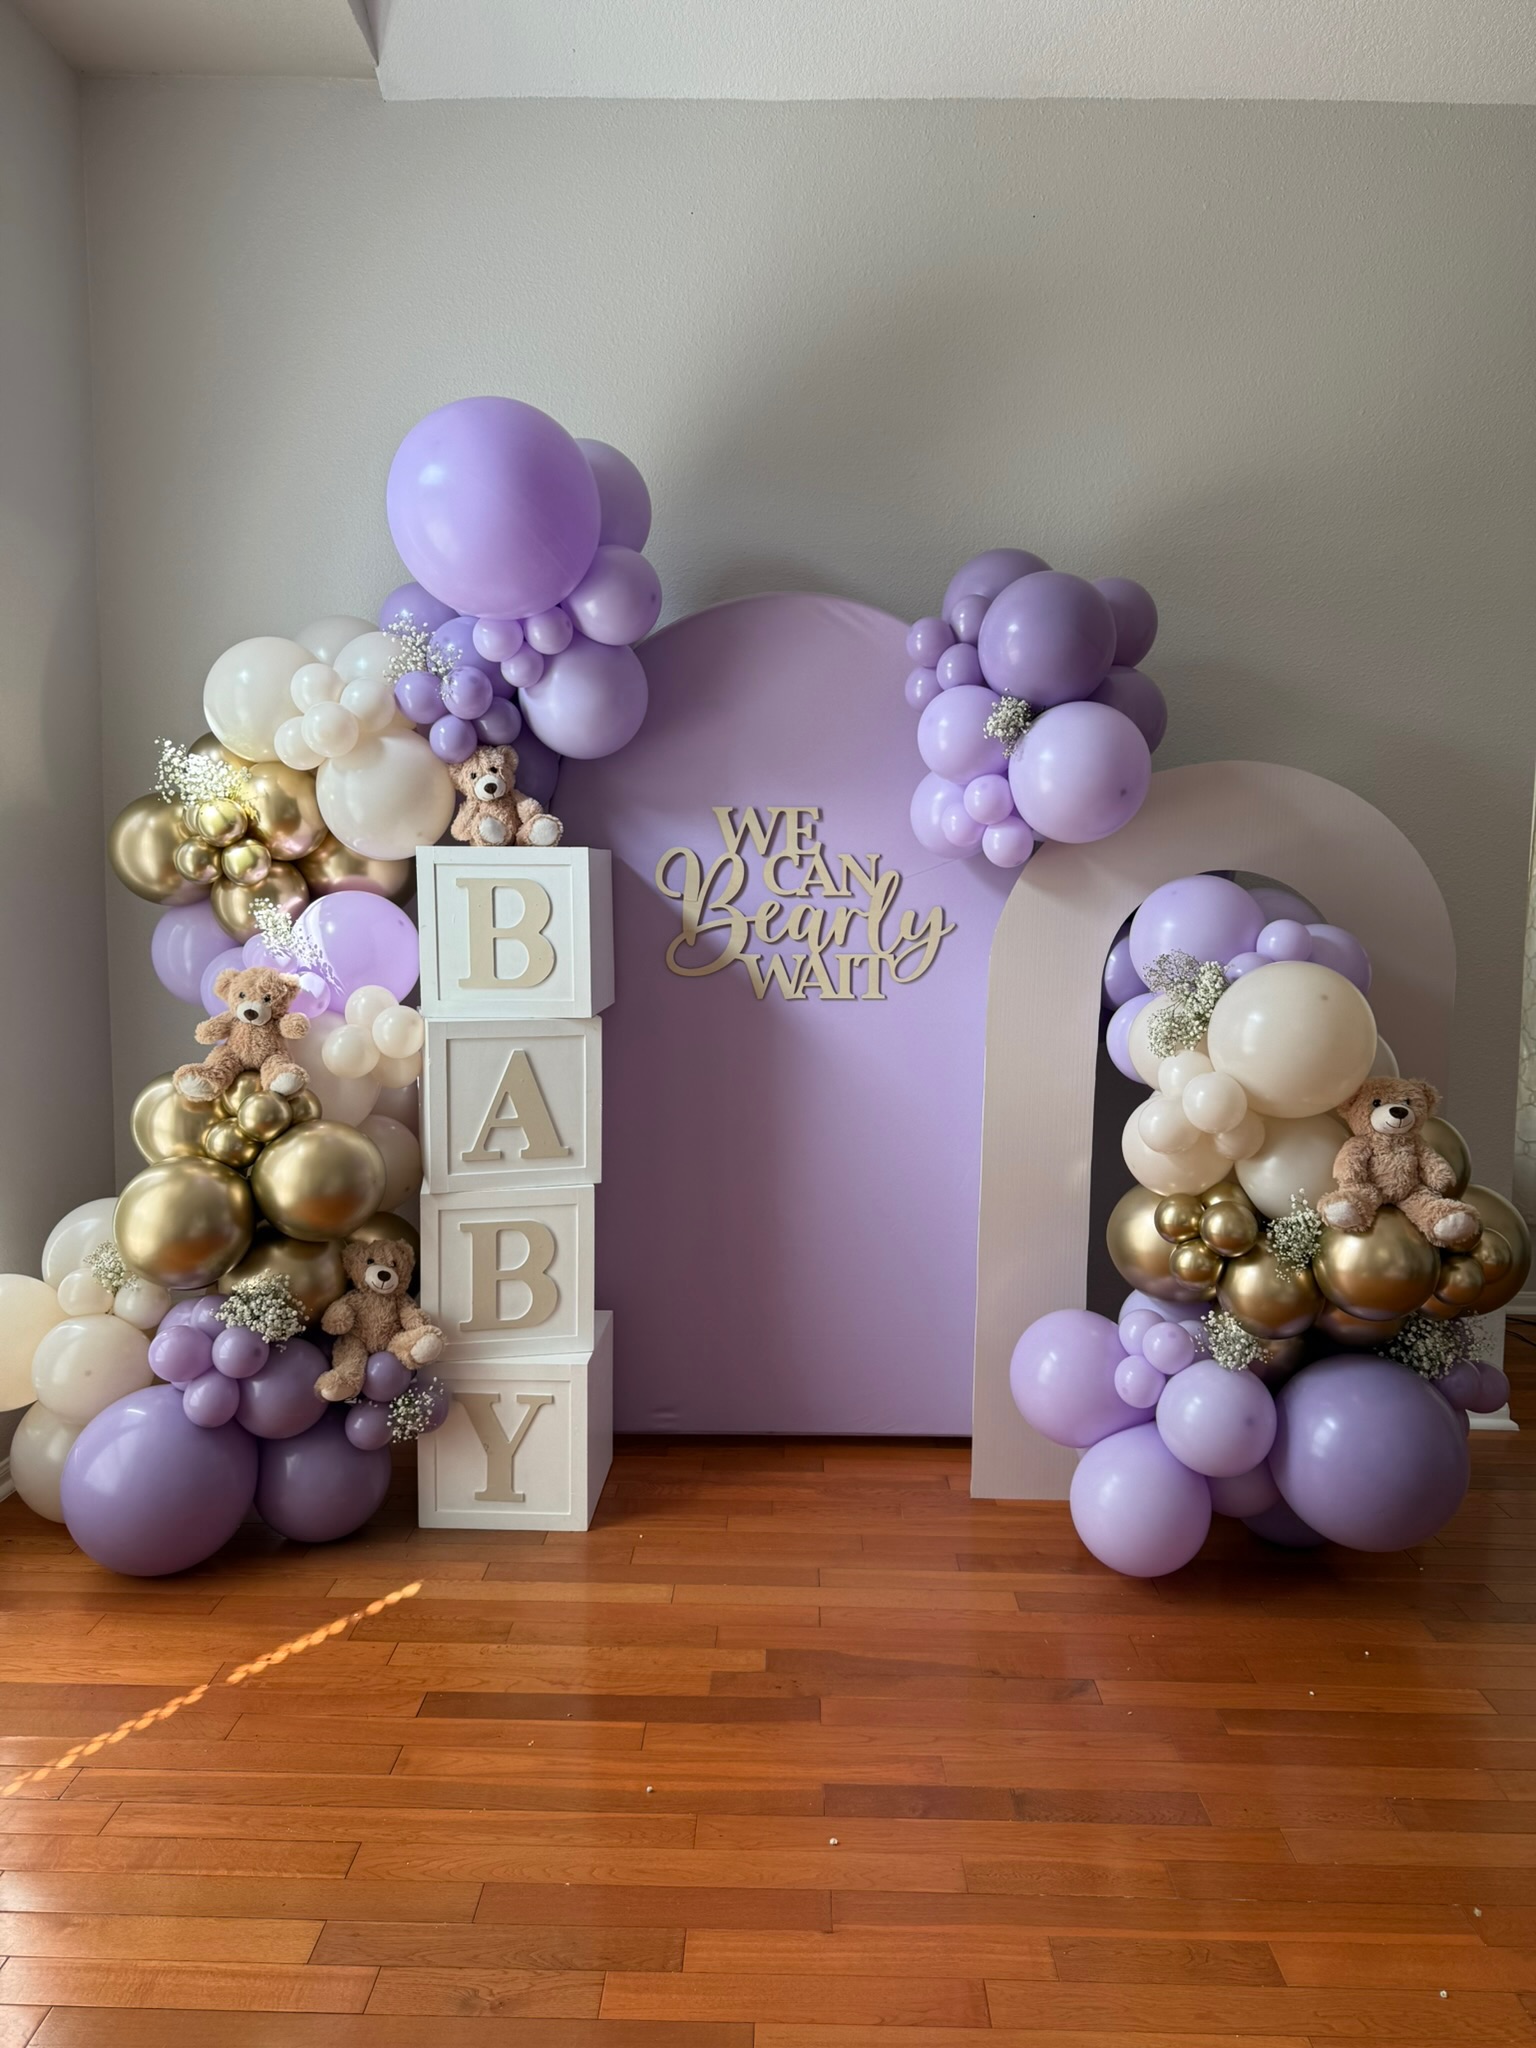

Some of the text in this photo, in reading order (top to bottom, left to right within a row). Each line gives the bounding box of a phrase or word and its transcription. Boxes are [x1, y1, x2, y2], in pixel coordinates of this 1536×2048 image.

[712, 806, 822, 856] WE
[763, 841, 880, 896] CAN
[655, 847, 957, 983] Bearly
[735, 953, 896, 1000] WAIT
[453, 877, 571, 1503] BABY
